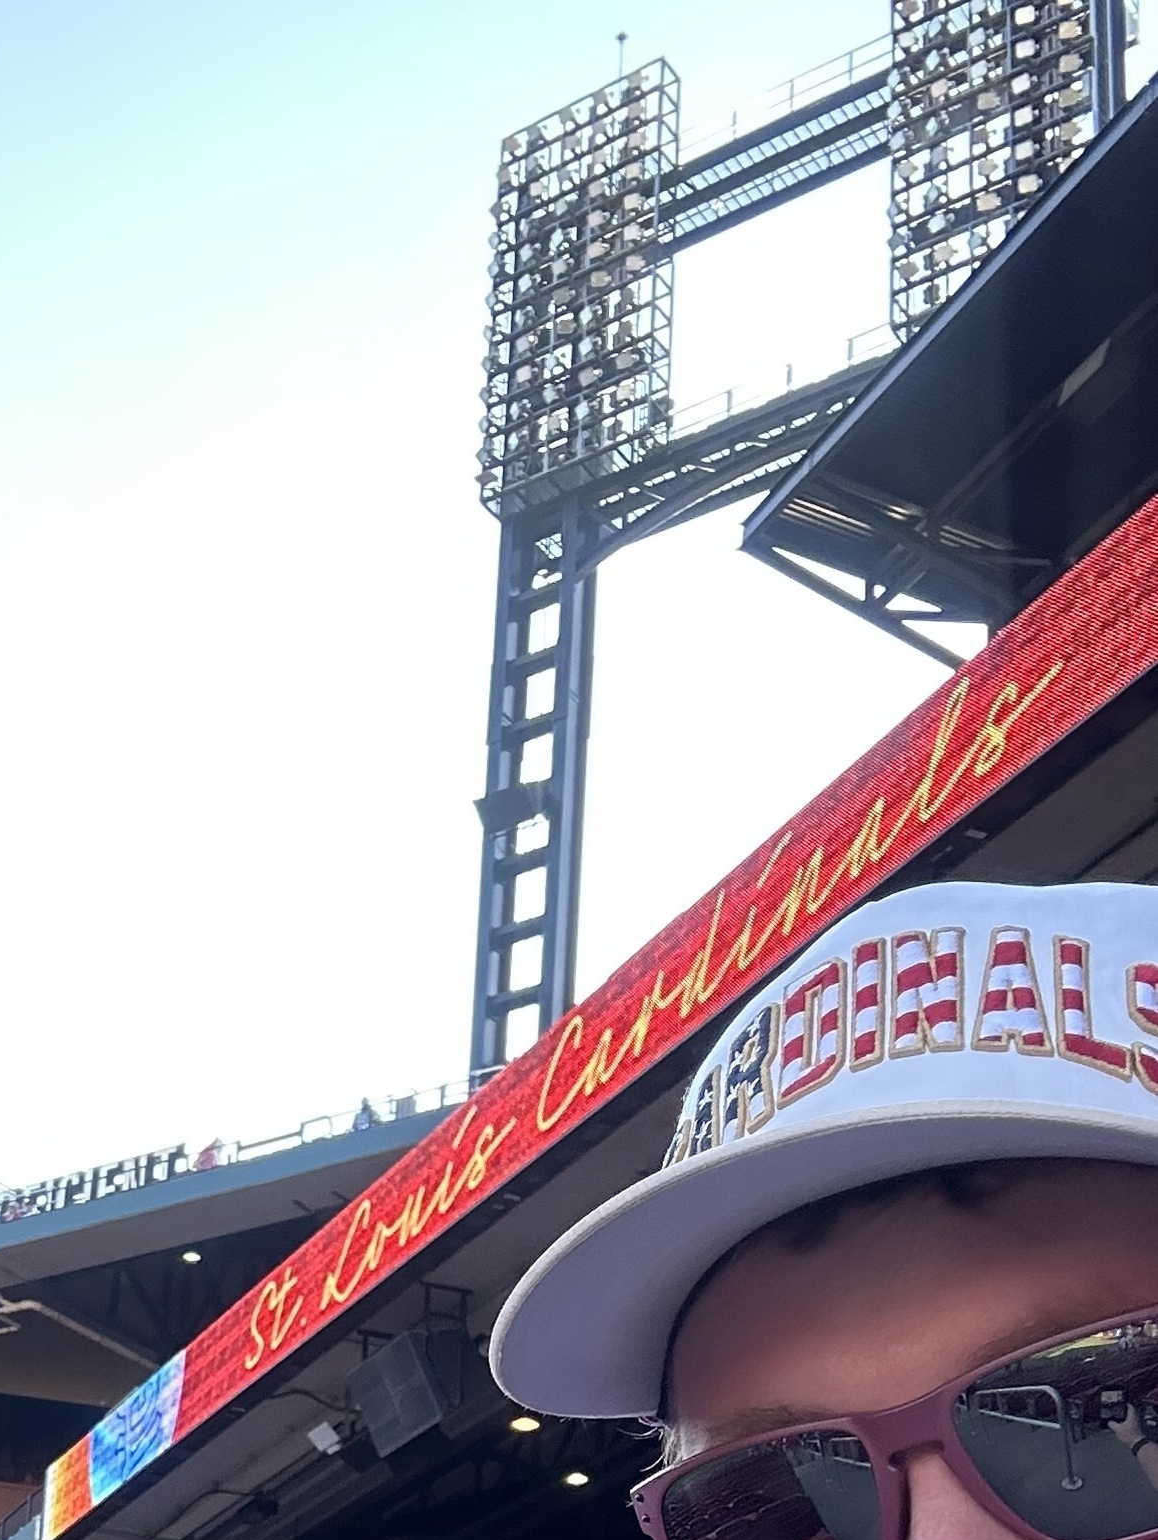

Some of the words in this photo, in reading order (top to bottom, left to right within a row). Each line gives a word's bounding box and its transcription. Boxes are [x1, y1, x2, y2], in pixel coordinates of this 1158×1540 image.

[244, 1266, 308, 1370] St.
[319, 1104, 517, 1311] Louis
[536, 661, 1063, 1131] Cardinals
[662, 925, 1158, 1168] ARDINAL
